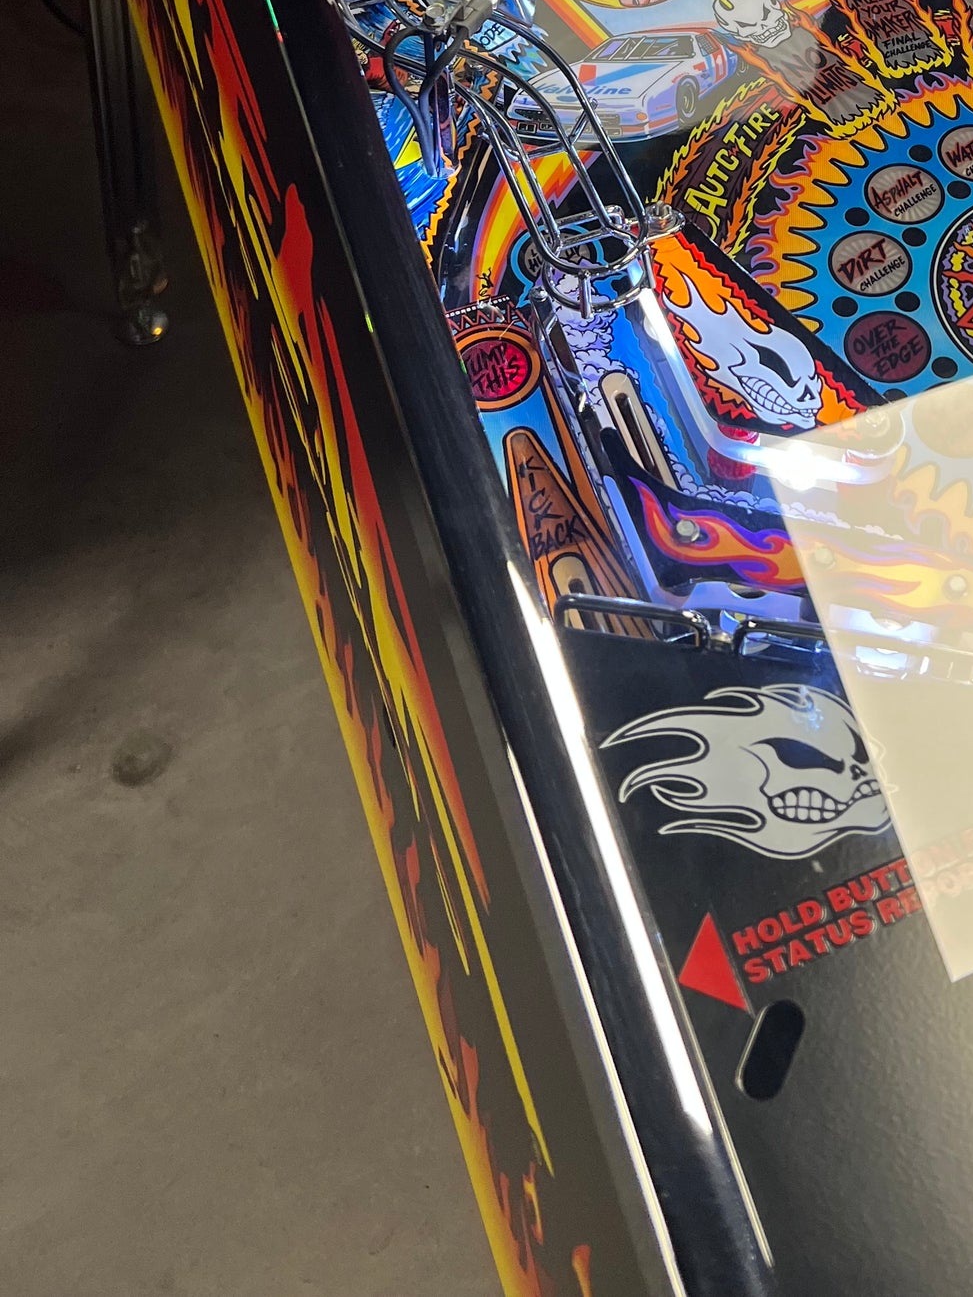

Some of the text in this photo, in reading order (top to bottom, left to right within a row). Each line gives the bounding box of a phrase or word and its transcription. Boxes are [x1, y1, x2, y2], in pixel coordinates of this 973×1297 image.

[861, 0, 908, 21] YOUR
[865, 10, 923, 39] MAKER
[882, 33, 921, 50] FINAL
[884, 39, 934, 58] CHALLENGE
[789, 46, 828, 79] NO
[534, 81, 632, 98] Valvline
[807, 62, 858, 104] LIMITS
[723, 103, 780, 158] FIRE
[871, 170, 923, 213] ASPHALT
[893, 183, 937, 217] CHALLENGE
[837, 238, 887, 284] DIRT
[860, 255, 906, 291] CHALLENGE
[853, 318, 907, 354] OVER
[873, 336, 900, 358] THE
[467, 342, 508, 377] UMP
[873, 335, 924, 378] EDGE
[472, 355, 521, 395] THIS
[519, 456, 563, 530] KICK
[531, 515, 588, 560] BACK
[732, 901, 824, 954] HOLD
[826, 842, 957, 912] BUTTON
[742, 911, 875, 983] STATUS
